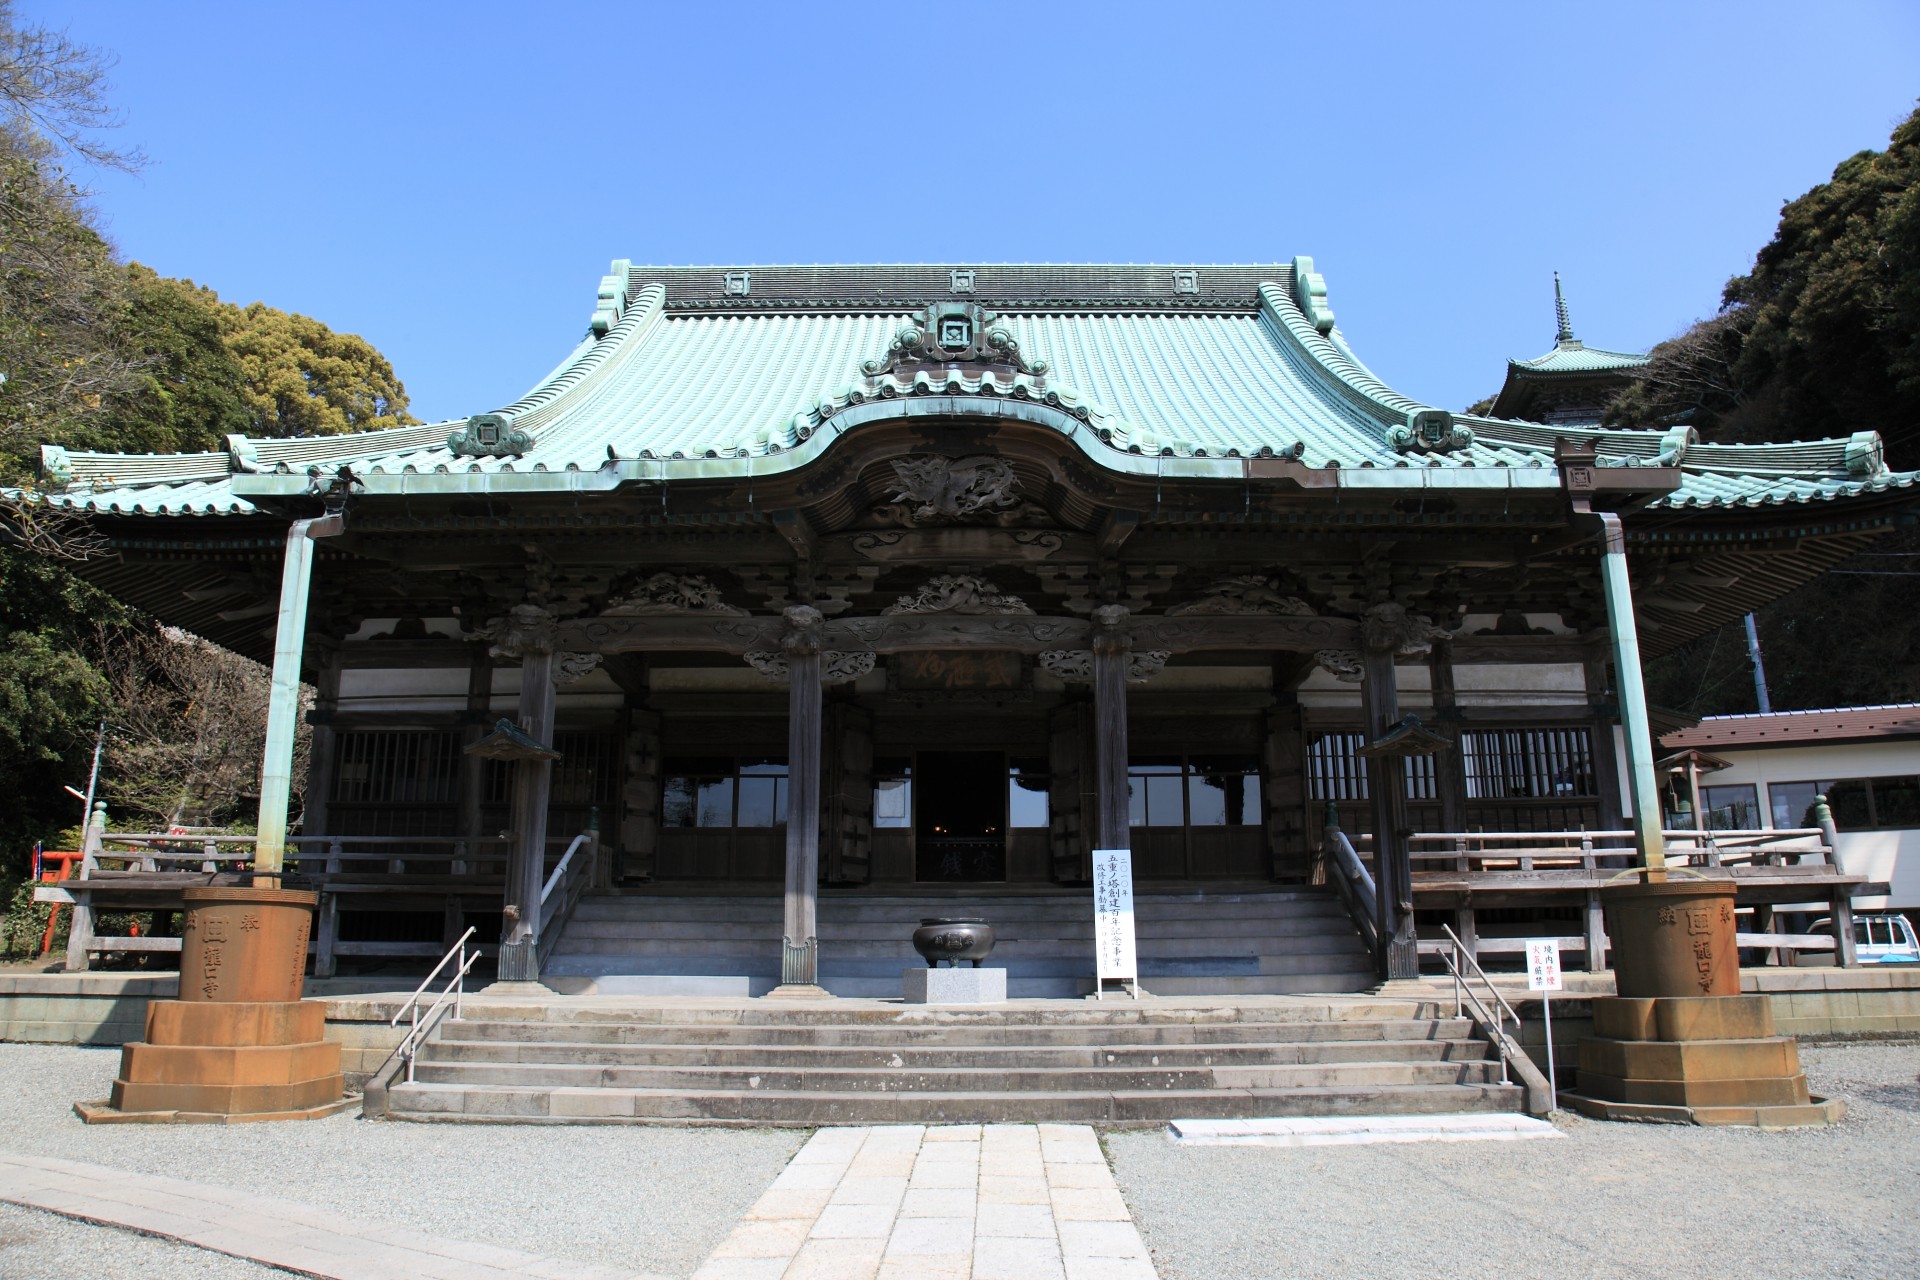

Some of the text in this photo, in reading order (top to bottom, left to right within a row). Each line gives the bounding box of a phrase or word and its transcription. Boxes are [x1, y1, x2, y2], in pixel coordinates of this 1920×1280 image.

[202, 946, 222, 999] 龍口寺
[1532, 945, 1544, 986] 火気厳禁
[1543, 945, 1556, 985] 境内禁煙
[1693, 940, 1714, 993] 龍口寺
